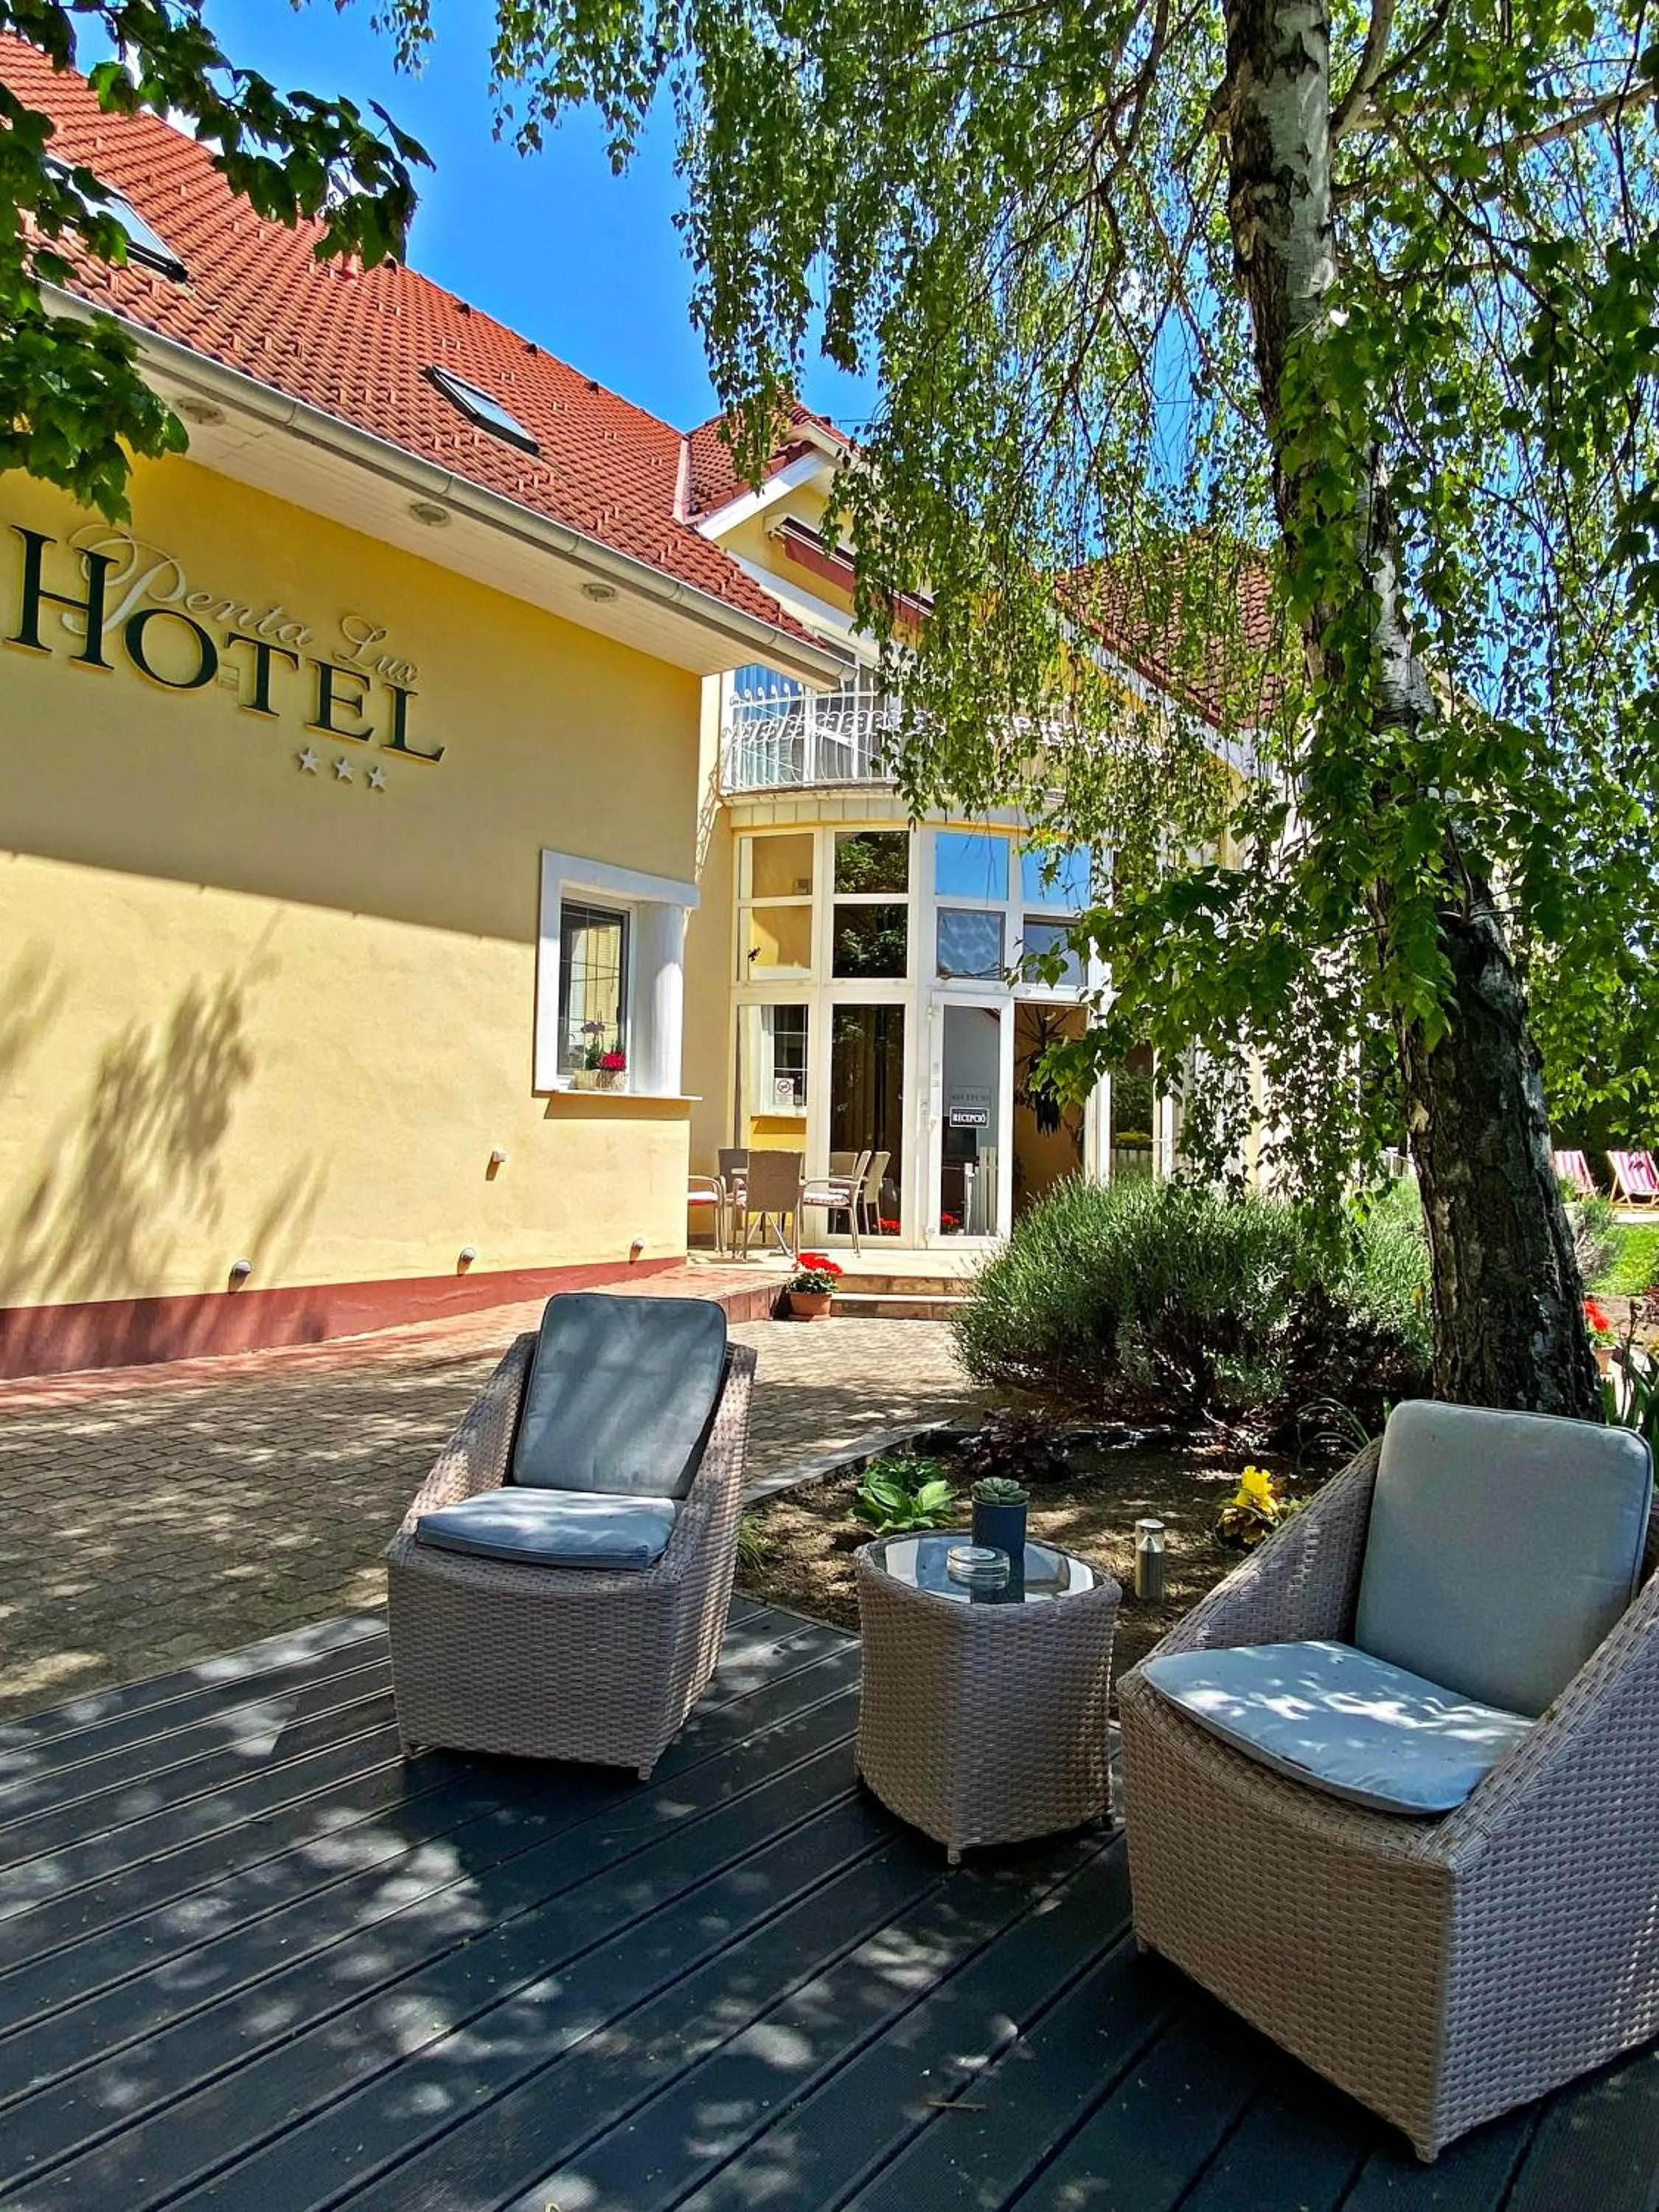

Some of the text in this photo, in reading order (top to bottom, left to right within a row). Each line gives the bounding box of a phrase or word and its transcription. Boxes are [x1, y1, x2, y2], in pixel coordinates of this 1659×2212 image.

[5, 524, 445, 762] HOTEL
[61, 524, 418, 685] Penta Lux
